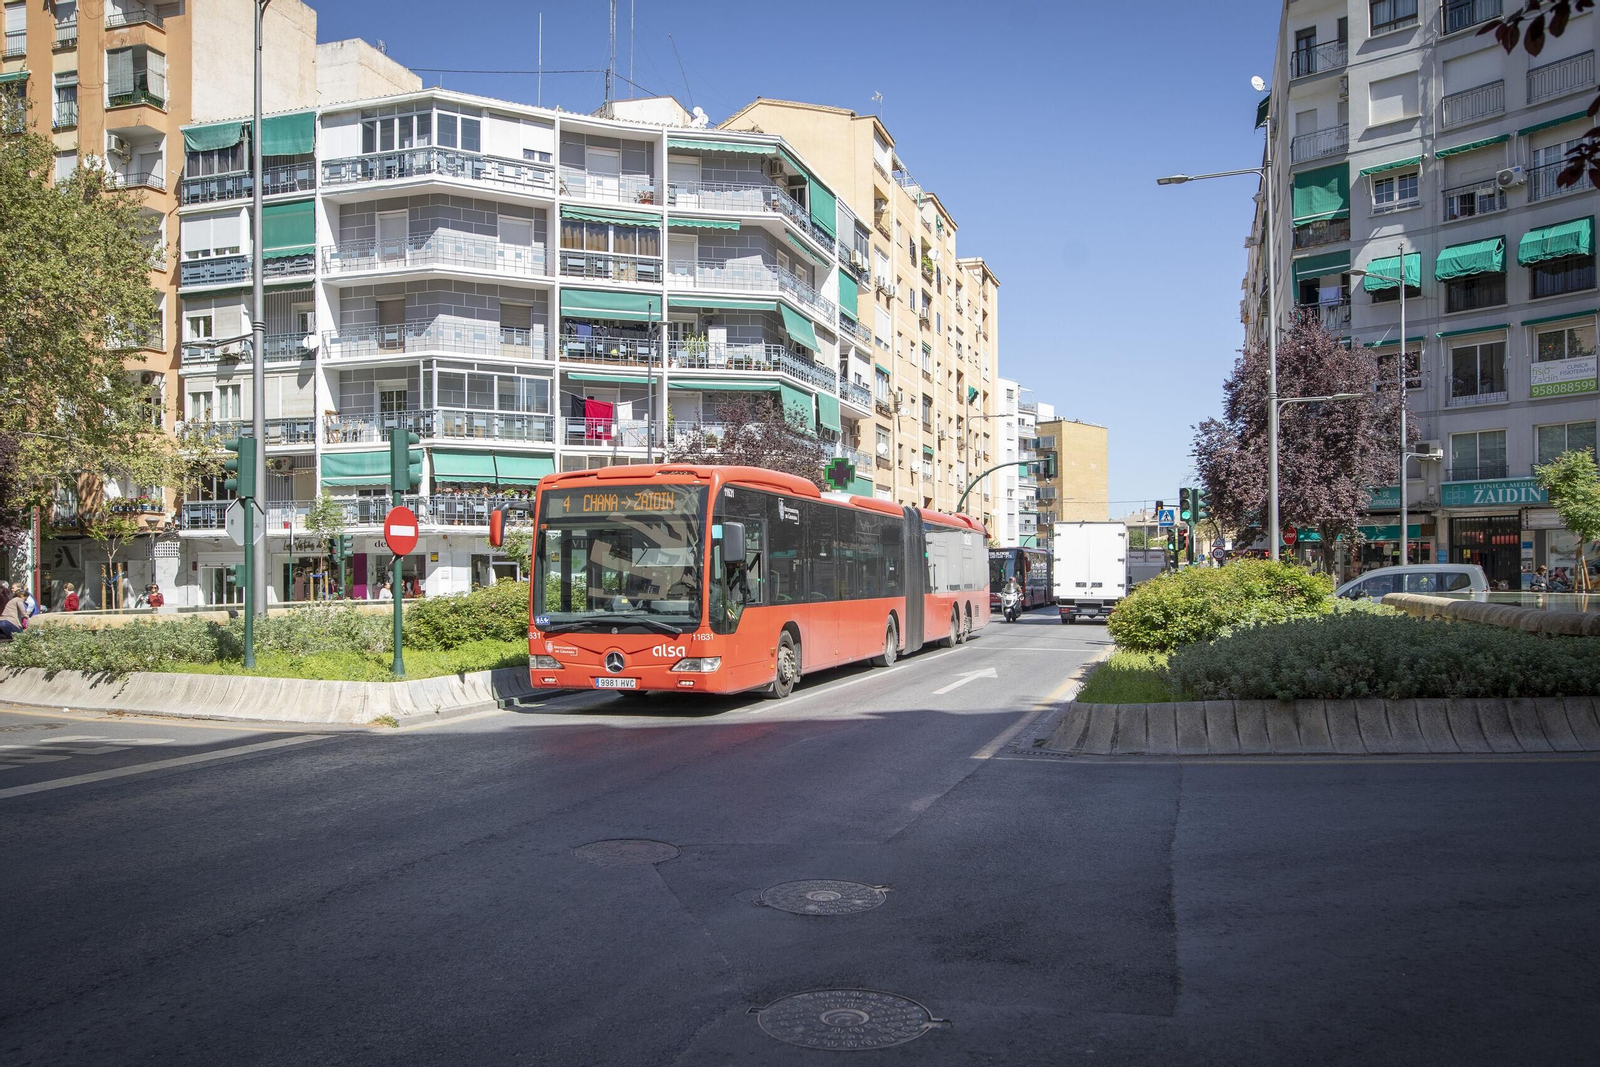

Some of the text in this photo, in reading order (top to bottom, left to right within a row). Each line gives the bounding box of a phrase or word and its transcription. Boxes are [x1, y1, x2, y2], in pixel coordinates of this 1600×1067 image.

[1559, 367, 1596, 376] FISIOTERAPIA
[1532, 380, 1596, 397] 958088599
[1473, 482, 1507, 490] CLINICA
[1473, 487, 1542, 504] ZAIDIN
[563, 491, 675, 513] 4 CHANA ZAIDIN
[692, 633, 714, 641] 11631
[652, 643, 686, 657] alsa
[600, 679, 635, 687] 9981 HVC
